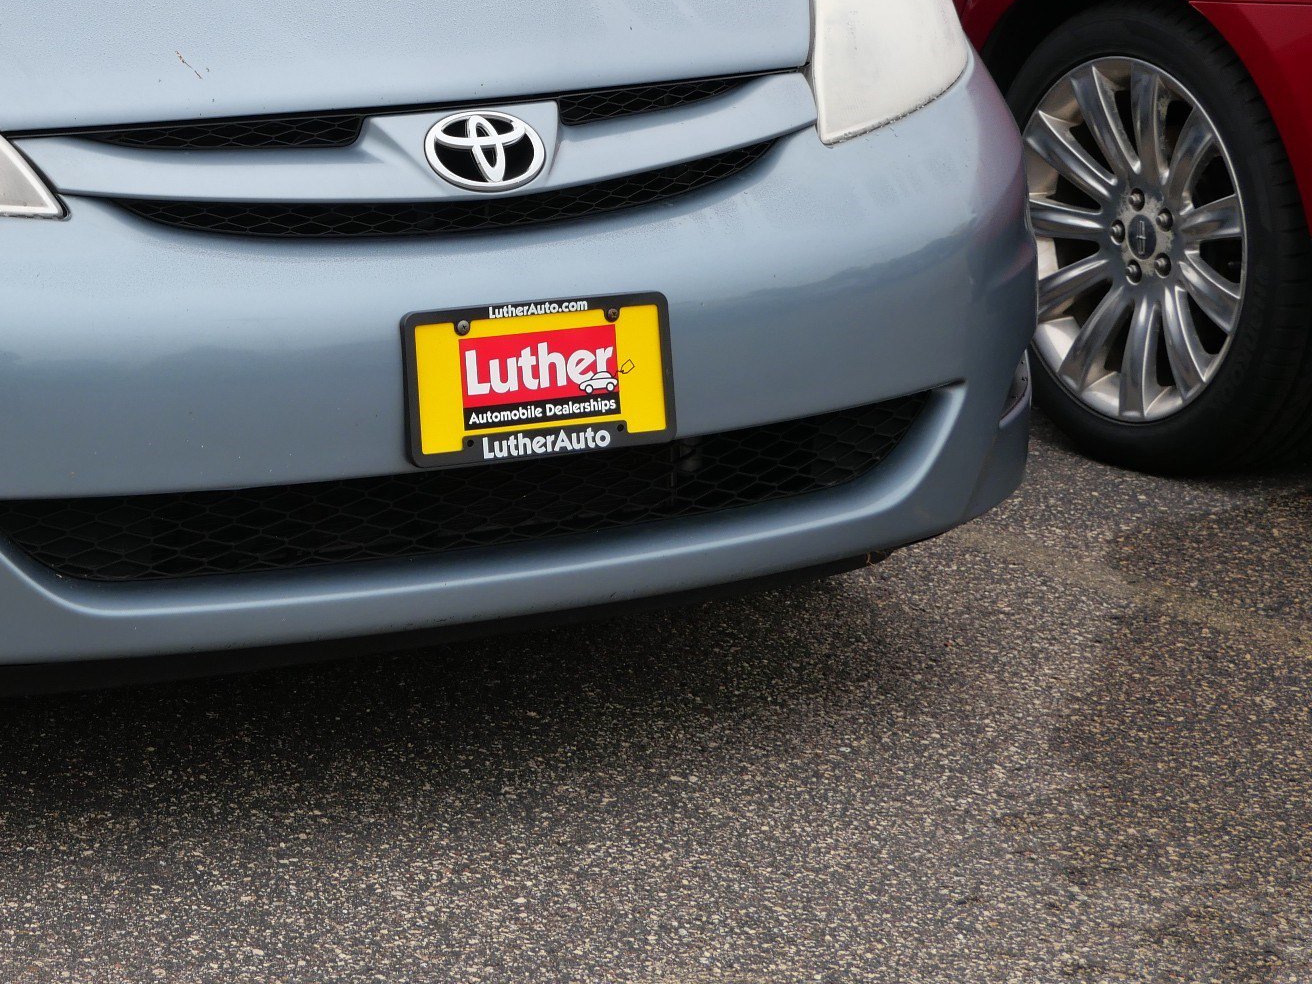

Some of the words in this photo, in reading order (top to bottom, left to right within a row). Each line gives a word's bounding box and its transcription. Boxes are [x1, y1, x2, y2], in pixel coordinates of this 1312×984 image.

[488, 300, 588, 319] LutherAuto.com
[465, 342, 613, 395] Luther
[469, 406, 542, 425] Automobile
[546, 399, 616, 415] Dealerships
[483, 427, 610, 459] LutherAuto
